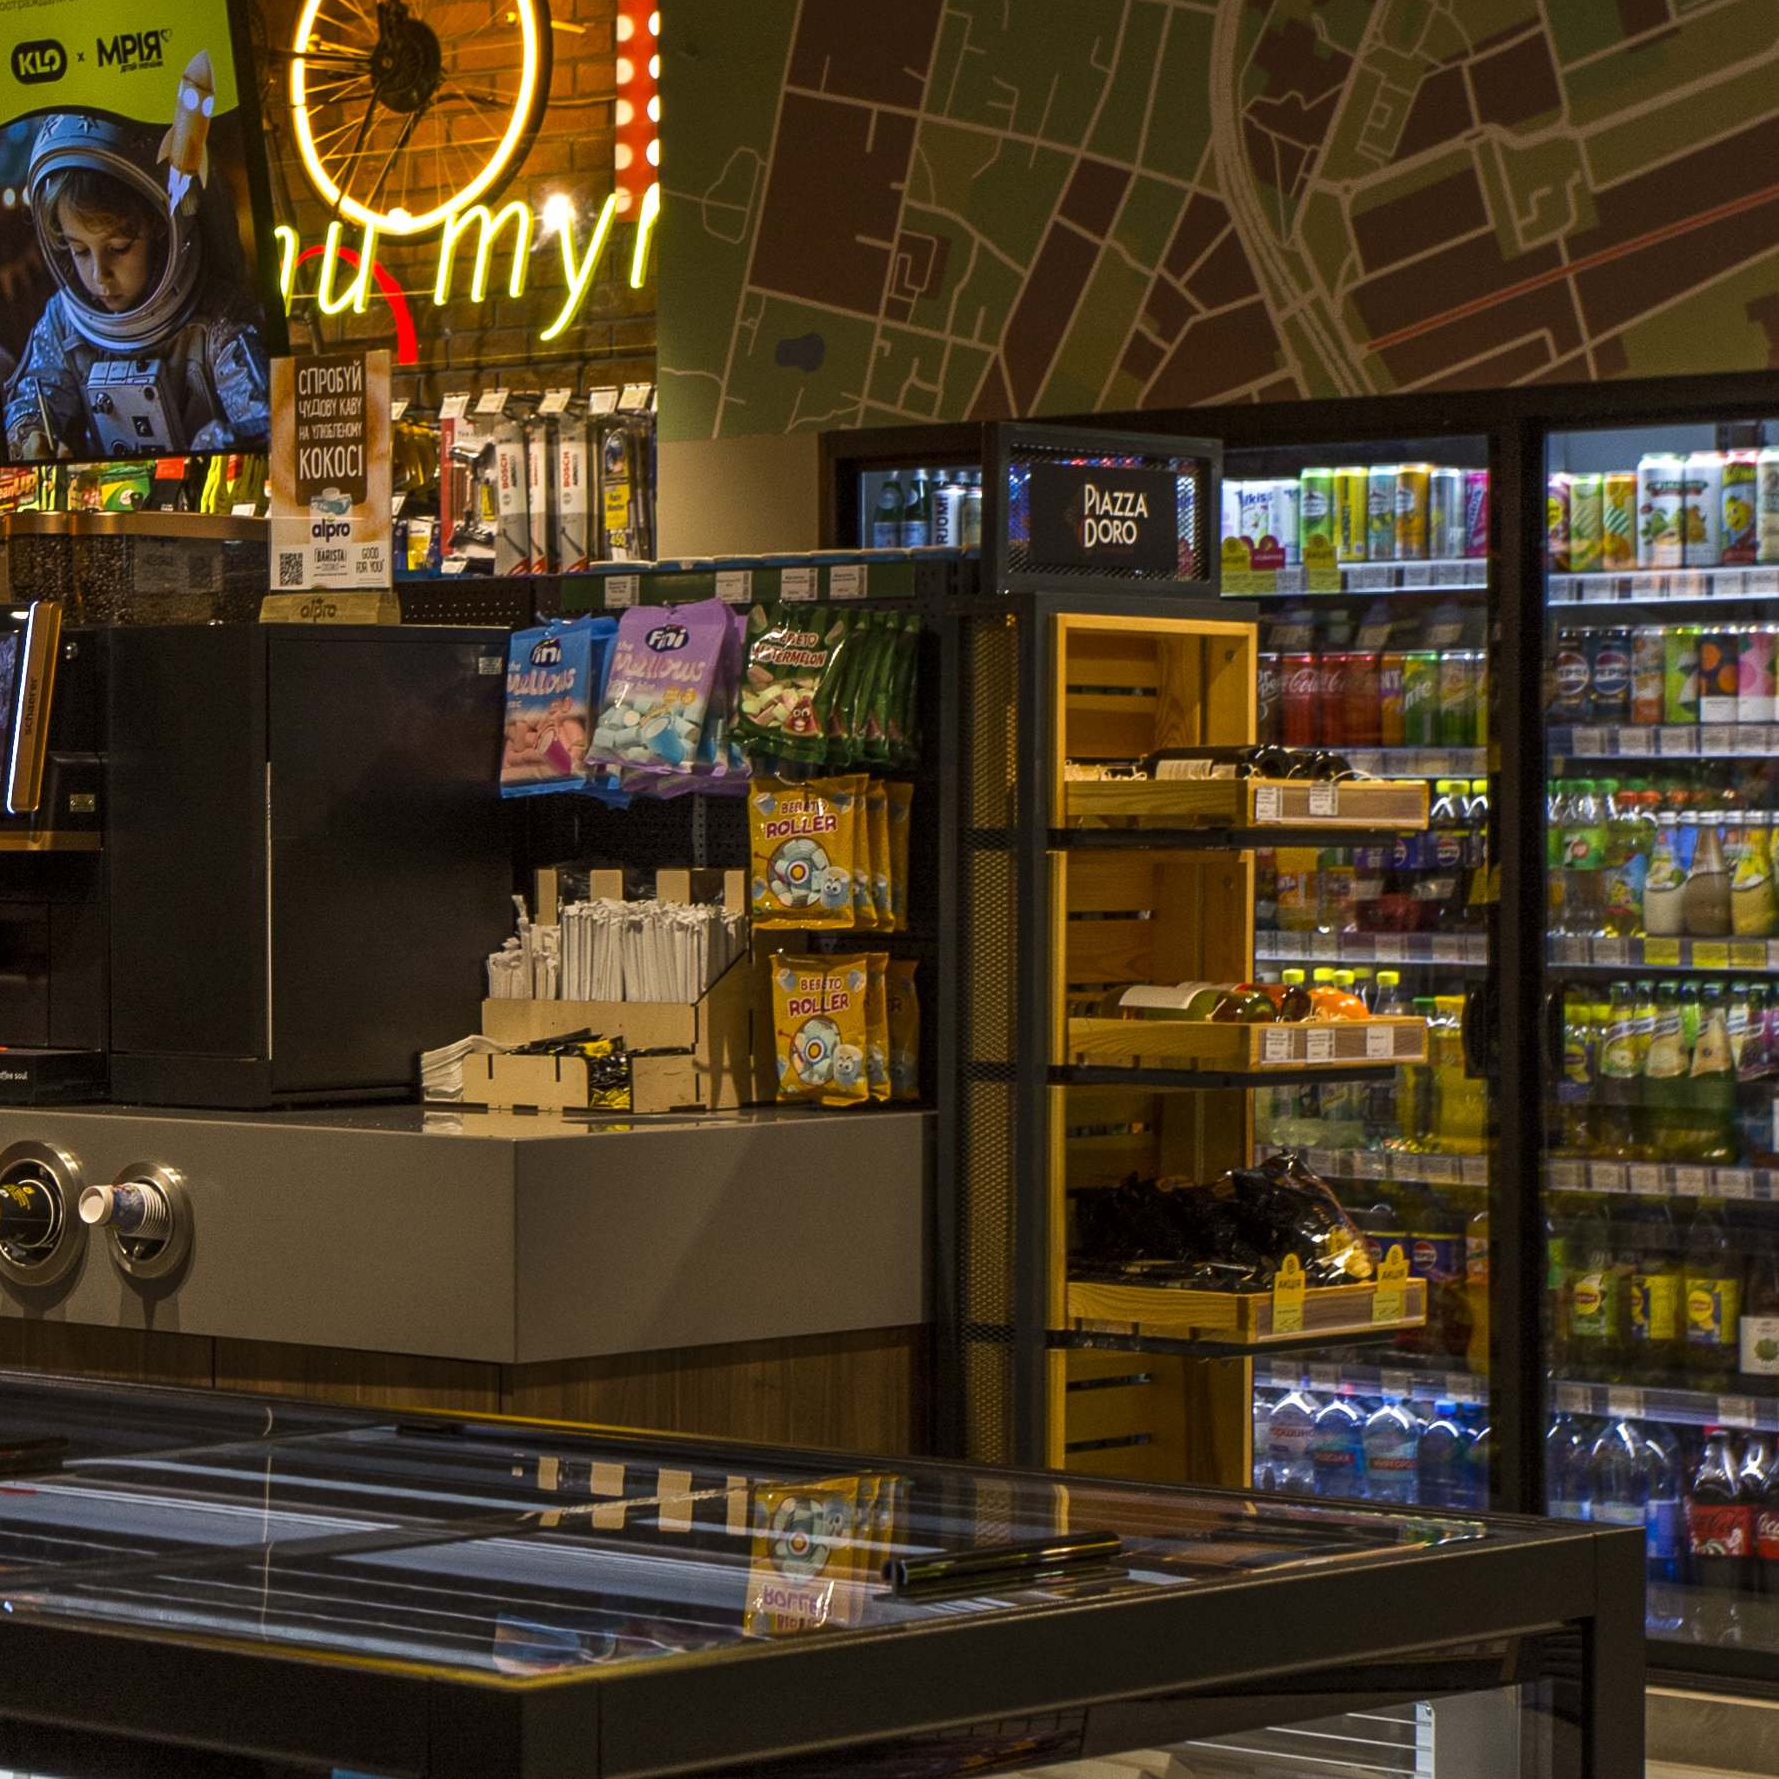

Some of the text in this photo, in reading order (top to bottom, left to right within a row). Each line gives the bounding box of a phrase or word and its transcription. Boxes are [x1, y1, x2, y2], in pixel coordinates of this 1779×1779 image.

[96, 30, 163, 68] МРІЯ
[298, 360, 363, 396] СПРОБУЙ
[298, 396, 363, 419] ЧУДОВУ КАВУ
[298, 421, 363, 440] НА УЛЮБЛЕНОМУ
[299, 444, 363, 480] КОКОСІ
[501, 453, 509, 489] BOSCH
[1083, 483, 1150, 519] PIAZZA
[311, 518, 351, 542] alpro
[1083, 519, 1139, 549] DORO
[315, 548, 346, 563] BARISTA
[300, 600, 338, 622] alpro
[647, 628, 688, 651] Fini
[23, 677, 40, 737] schaerer
[767, 814, 838, 839] ROLLER
[800, 977, 843, 991] BEBETO
[788, 992, 850, 1017] ROLLER
[14, 1071, 28, 1080] soul
[1277, 1278, 1301, 1291] АКЦІЯ
